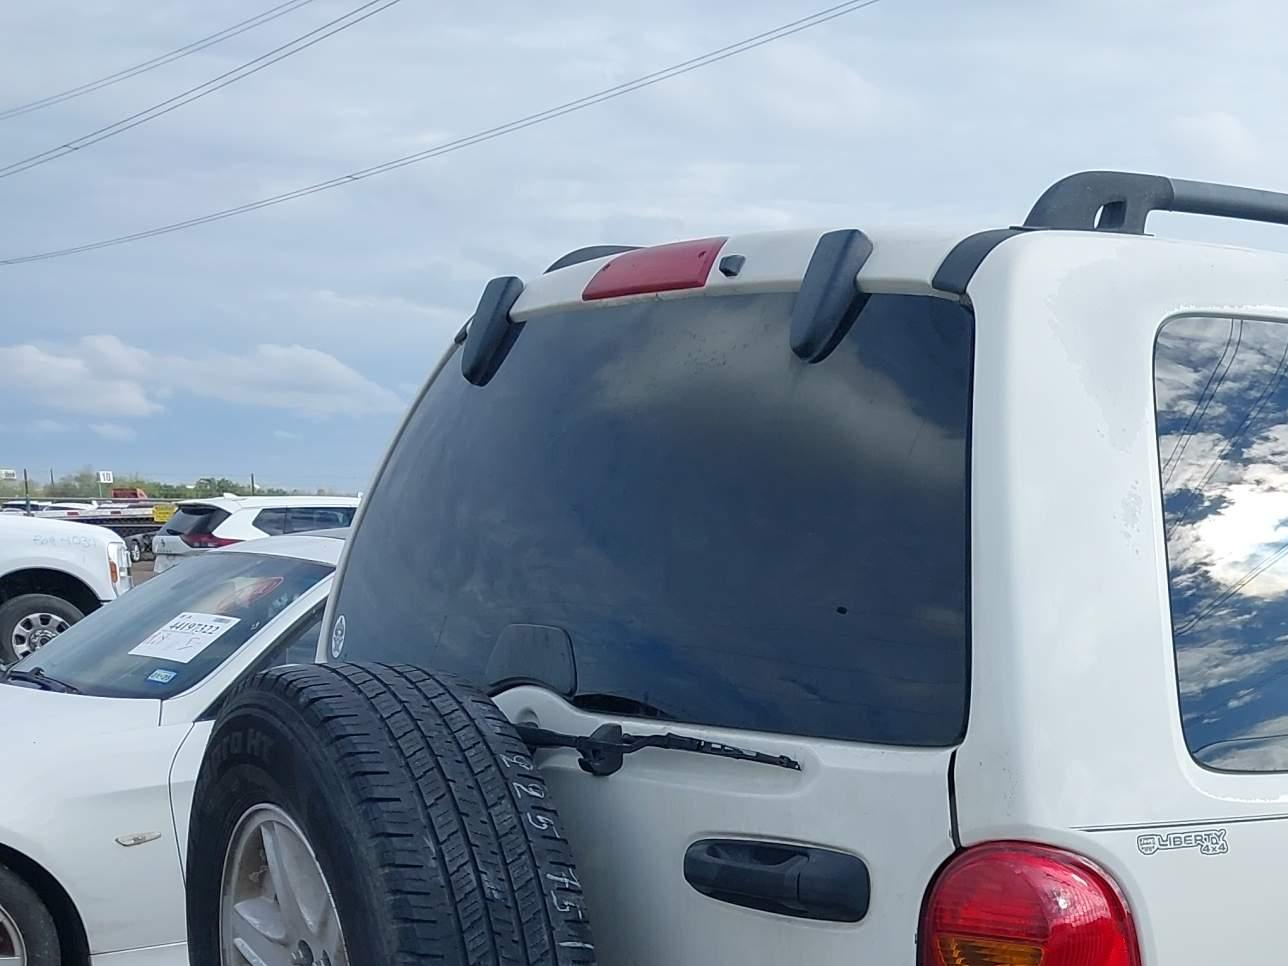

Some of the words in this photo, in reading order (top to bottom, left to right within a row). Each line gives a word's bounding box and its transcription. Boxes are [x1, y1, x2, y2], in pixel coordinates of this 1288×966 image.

[102, 472, 112, 482] 10
[1157, 831, 1224, 847] LIBERTY
[1202, 843, 1226, 853] 4x4
